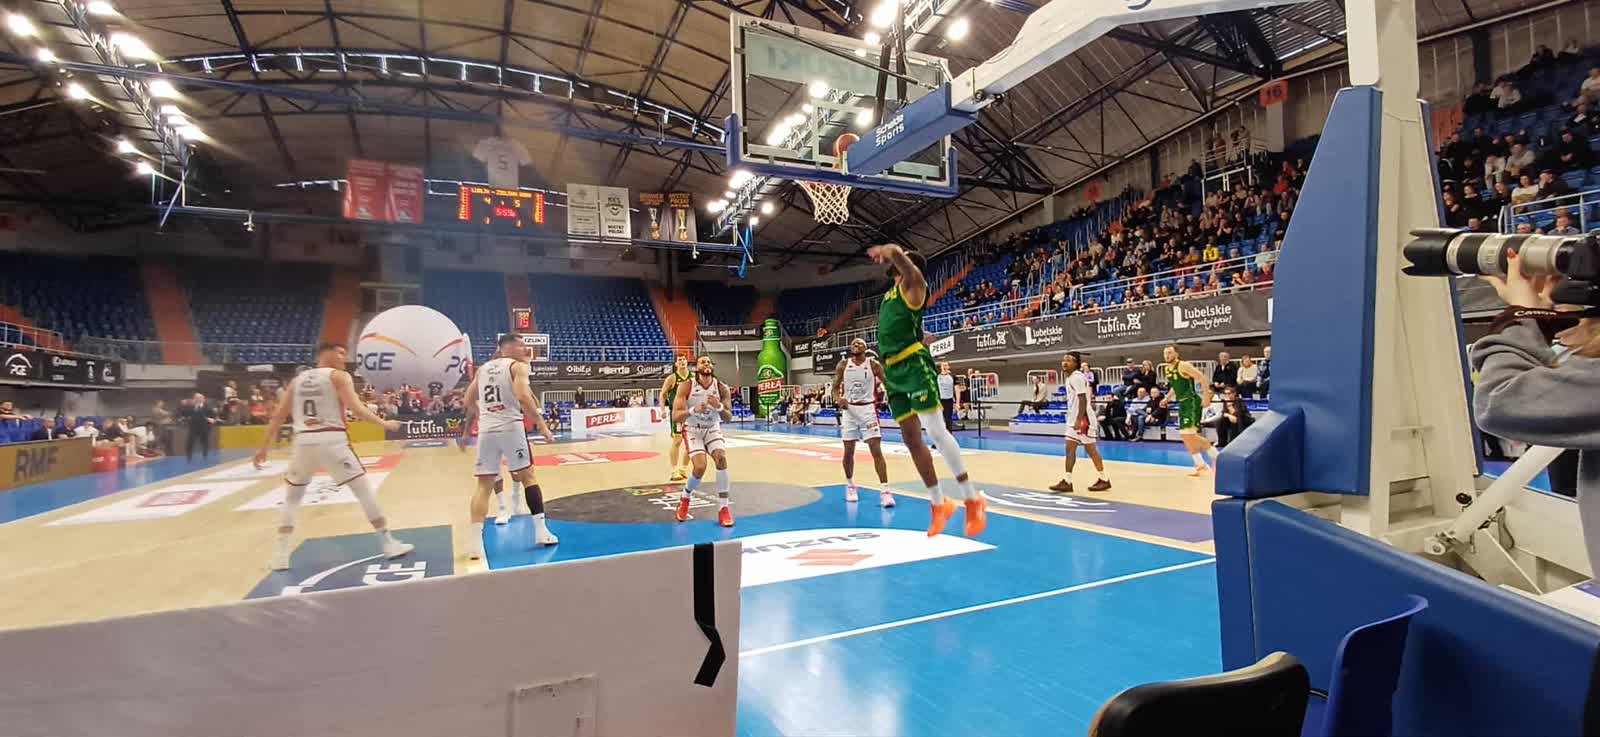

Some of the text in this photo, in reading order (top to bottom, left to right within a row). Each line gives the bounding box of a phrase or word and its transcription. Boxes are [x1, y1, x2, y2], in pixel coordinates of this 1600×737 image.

[1184, 304, 1232, 320] lubelskie
[1513, 310, 1558, 318] Canon
[1032, 325, 1064, 338] lubelskie
[1092, 316, 1127, 335] lublin
[484, 385, 502, 403] 21
[303, 400, 317, 417] 0
[404, 420, 444, 435] lublin
[15, 447, 58, 482] RMF
[741, 532, 881, 554] SUZUK
